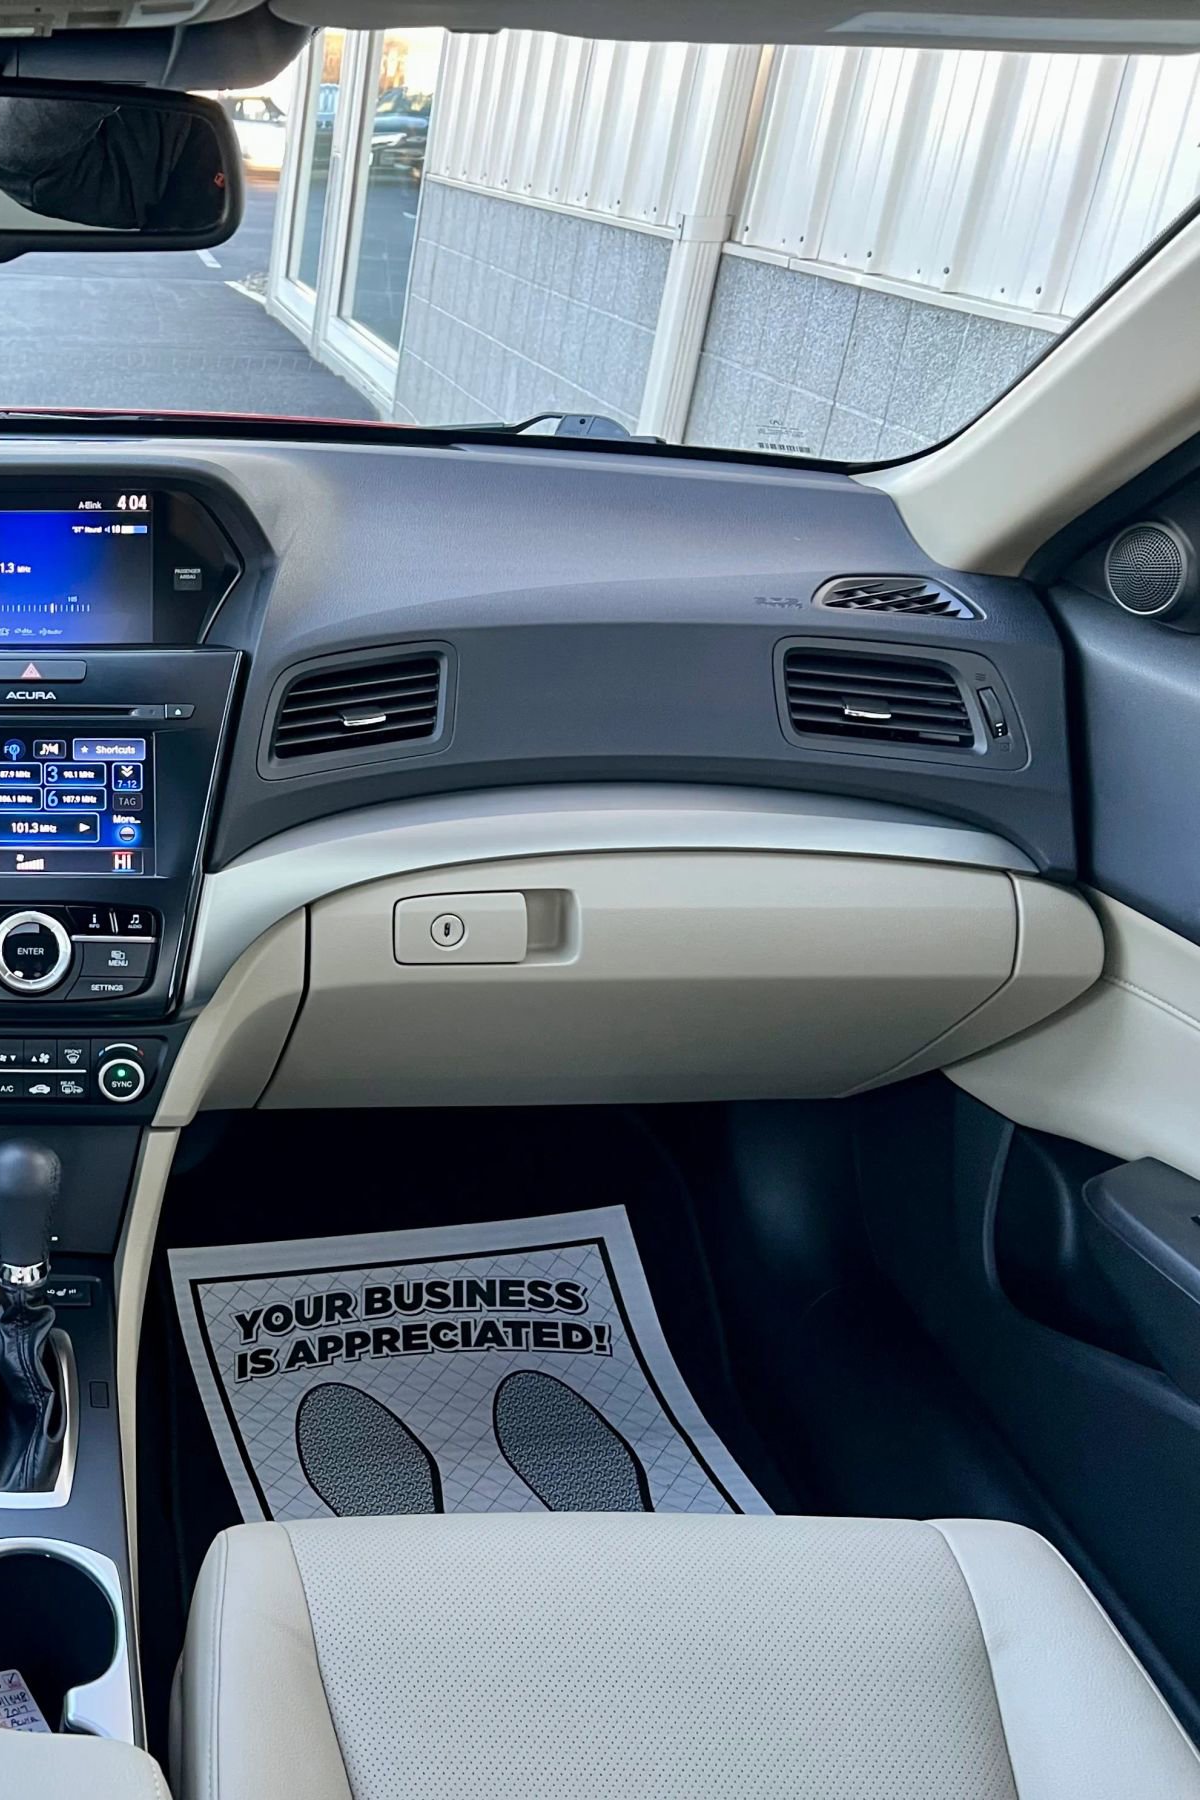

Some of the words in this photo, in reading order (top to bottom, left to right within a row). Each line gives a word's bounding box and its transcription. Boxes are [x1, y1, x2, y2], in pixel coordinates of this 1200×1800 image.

[6, 691, 56, 700] ACURA
[96, 745, 135, 755] Shortcuts
[47, 766, 58, 782] 3
[118, 780, 137, 788] 7-12
[47, 791, 59, 807] 6
[119, 798, 136, 806] TAG
[11, 823, 39, 833] 101.3
[17, 947, 45, 956] ENTER
[108, 959, 128, 967] MENU
[231, 1290, 357, 1343] YOUR
[364, 1276, 587, 1317] BUSINESS
[234, 1350, 278, 1382] IS
[280, 1318, 611, 1372] APPRECIATED!
